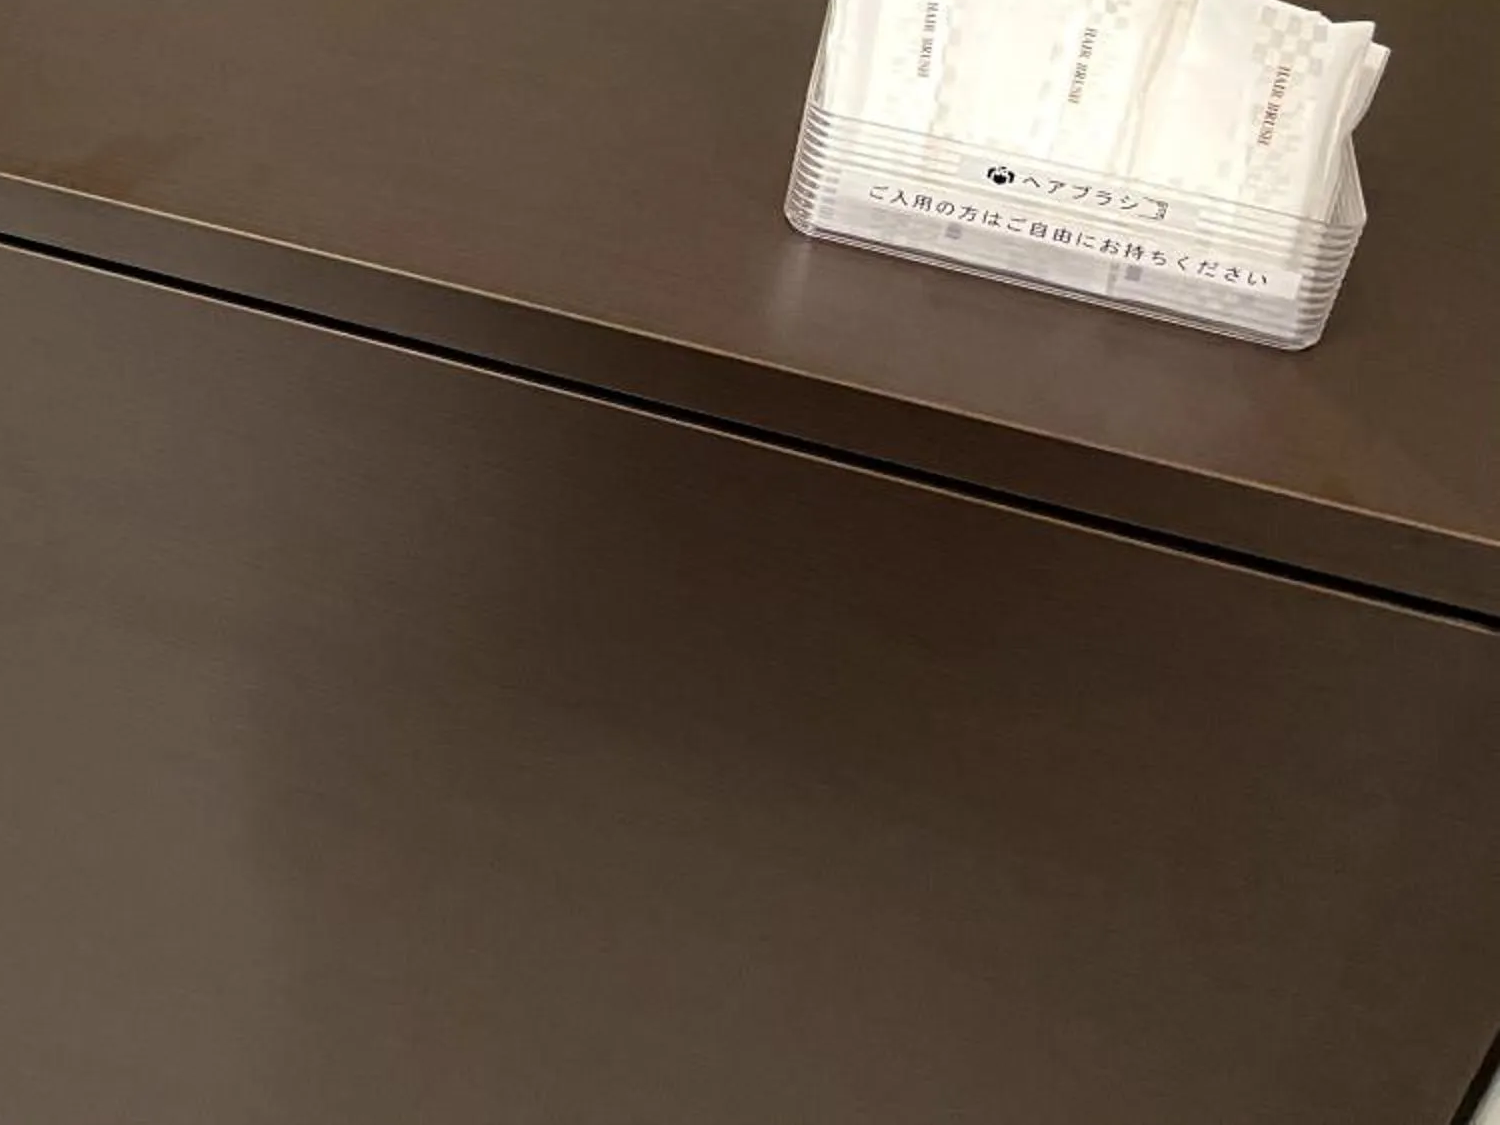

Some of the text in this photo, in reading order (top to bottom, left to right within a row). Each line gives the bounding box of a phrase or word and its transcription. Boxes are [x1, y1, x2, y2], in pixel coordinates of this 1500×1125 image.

[916, 1, 940, 78] HAIR BRUSH
[1067, 26, 1099, 105] HAIR BRUSH
[1256, 65, 1292, 147] HAIR BRUSH
[1022, 175, 1140, 212] ヘアブラシ
[868, 183, 1269, 287] ご入用の方はご自由にお持ちください
